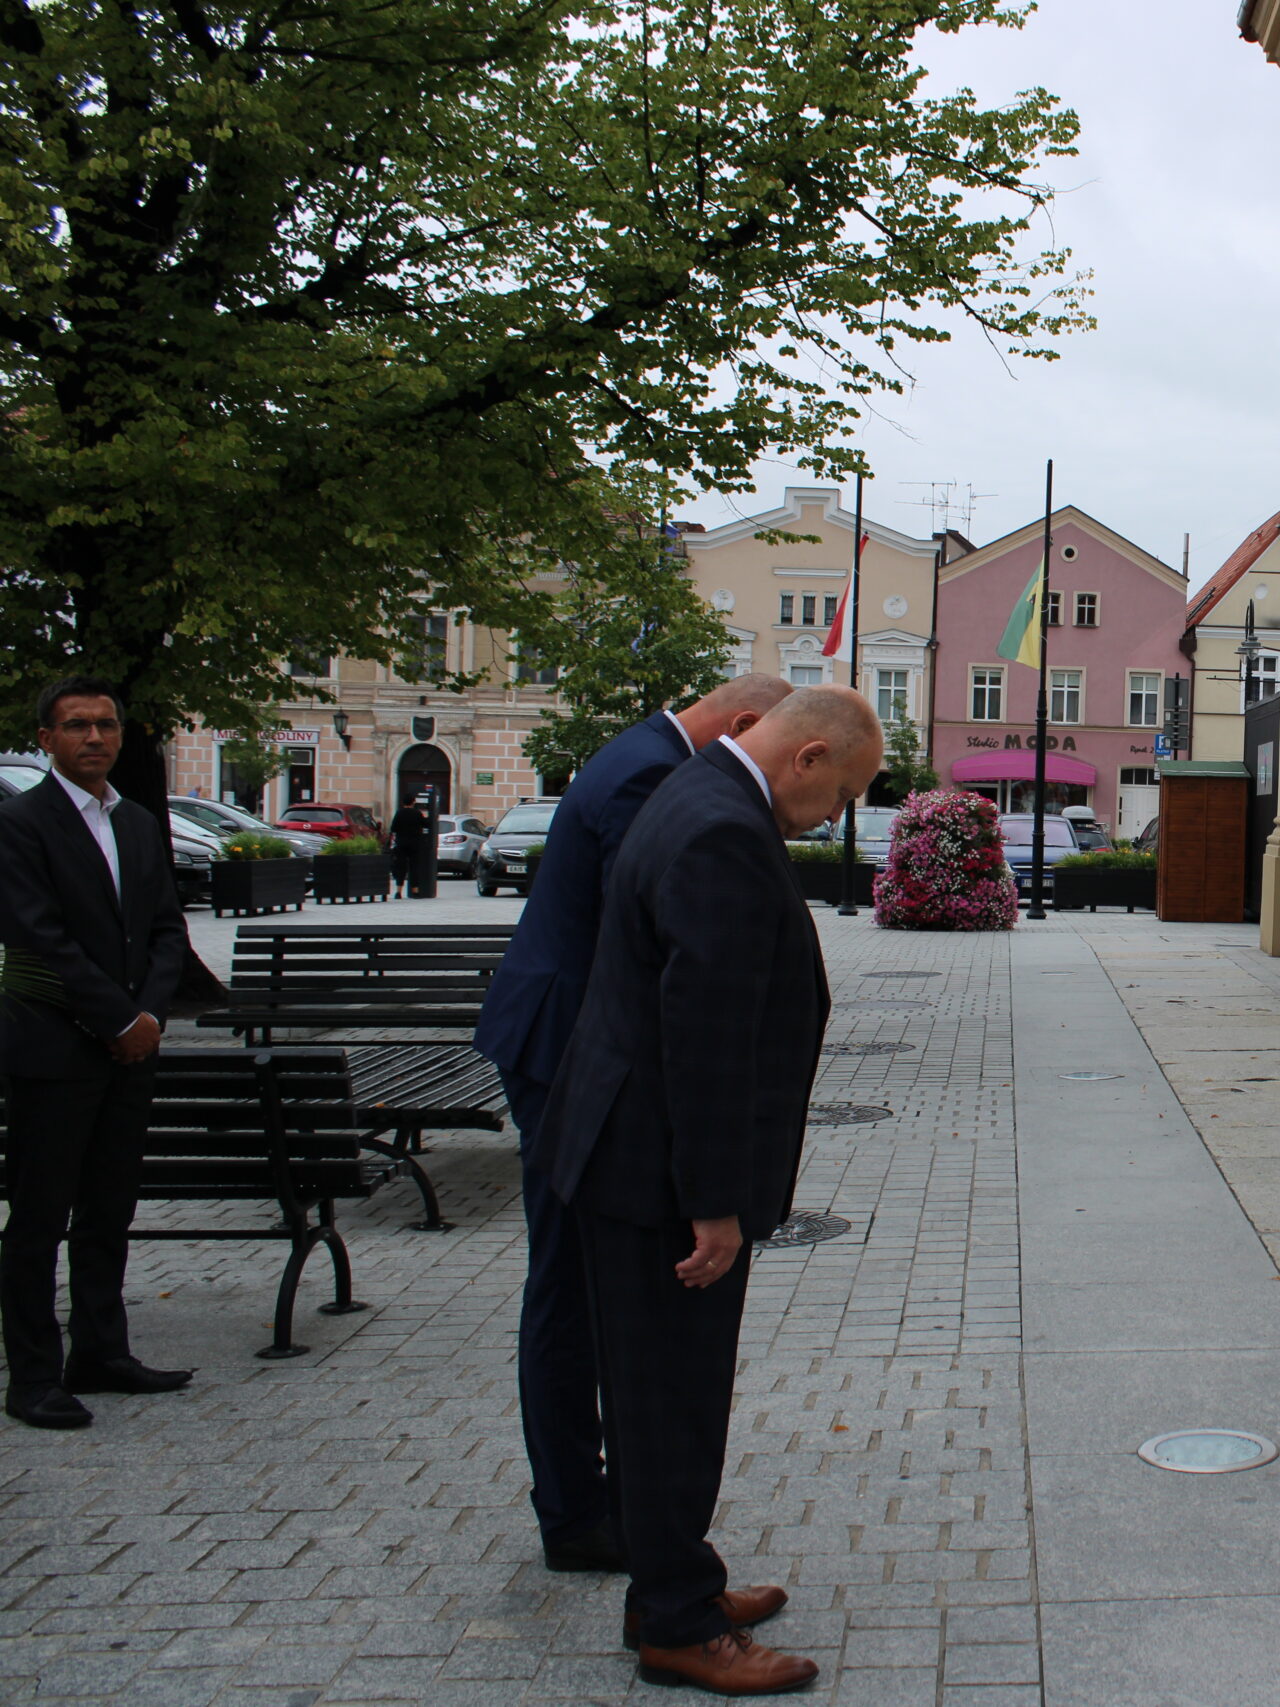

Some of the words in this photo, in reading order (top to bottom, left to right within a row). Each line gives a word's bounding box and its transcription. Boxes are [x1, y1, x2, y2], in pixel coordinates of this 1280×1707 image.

[256, 730, 313, 742] WDLINY
[967, 735, 1000, 749] Studio
[1005, 734, 1077, 751] MODA
